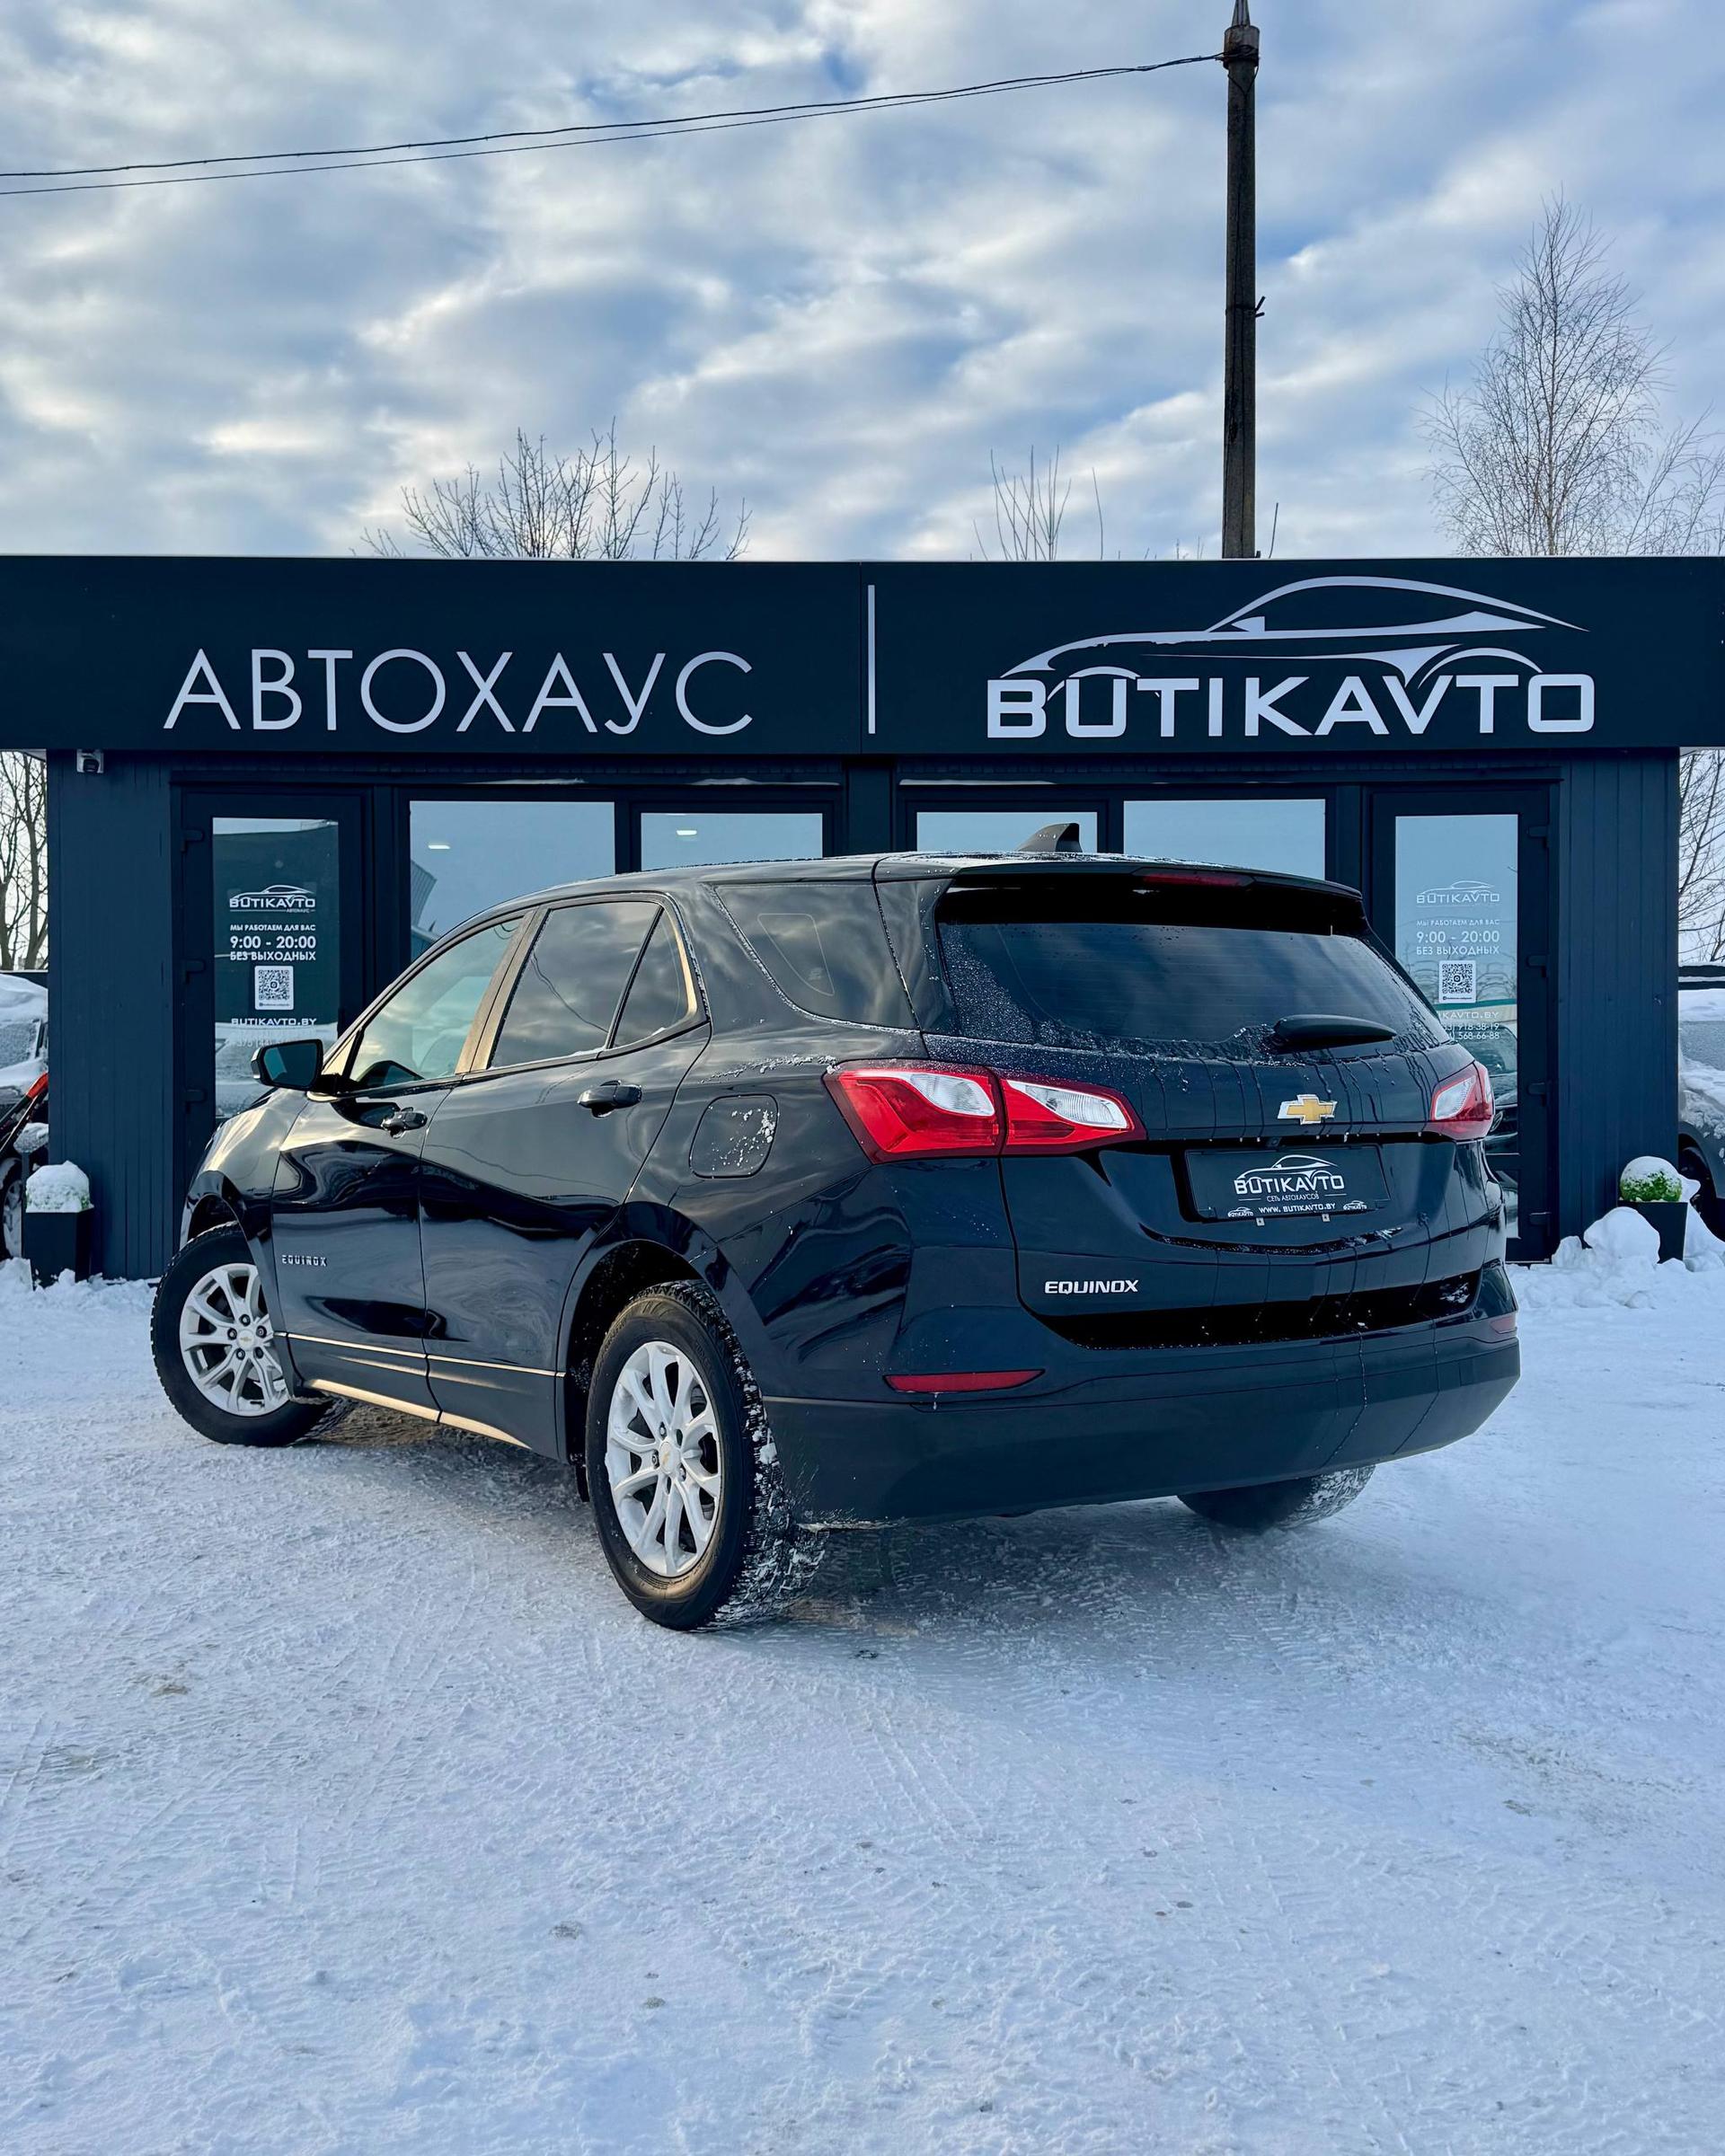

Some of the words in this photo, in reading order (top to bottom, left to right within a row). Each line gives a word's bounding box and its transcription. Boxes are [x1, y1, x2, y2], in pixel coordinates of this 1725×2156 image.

[164, 648, 754, 736] АВТОХАУС
[986, 672, 1596, 739] BUTIKAVTO
[229, 897, 316, 908] BUTIKAVTO
[1416, 893, 1500, 904] BUTIKAVTO
[230, 923, 243, 932] МЫ
[244, 923, 283, 932] РАБОТАЕМ
[284, 923, 299, 932] ДЛЯ
[300, 923, 316, 932] ВАС
[1416, 919, 1429, 927] МЫ
[1430, 919, 1468, 927] РАБОТАЕМ
[1469, 919, 1483, 927] ДЛЯ
[230, 935, 261, 949] 9:00
[276, 935, 316, 949] 20:00
[1416, 931, 1446, 943] 9:00
[1461, 930, 1500, 943] 20:00
[230, 950, 249, 961] БЕЗ
[251, 950, 316, 962] ВЫХОДНЫХ
[1416, 946, 1433, 956] БЕЗ
[1436, 945, 1499, 956] ВЫХОДНЫХ
[1438, 1011, 1499, 1020] IKAVTO.BY
[231, 1018, 317, 1027] BUTIKAVTO.BY
[1457, 1022, 1499, 1031] 918-38-19
[1457, 1031, 1500, 1040] 568-66-88
[1234, 1175, 1345, 1195] BUTIKAVTO
[1282, 1203, 1336, 1213] BUTIKAVTO.BY
[281, 1254, 327, 1268] EQUINOX
[1044, 1279, 1139, 1294] EQUINOX
